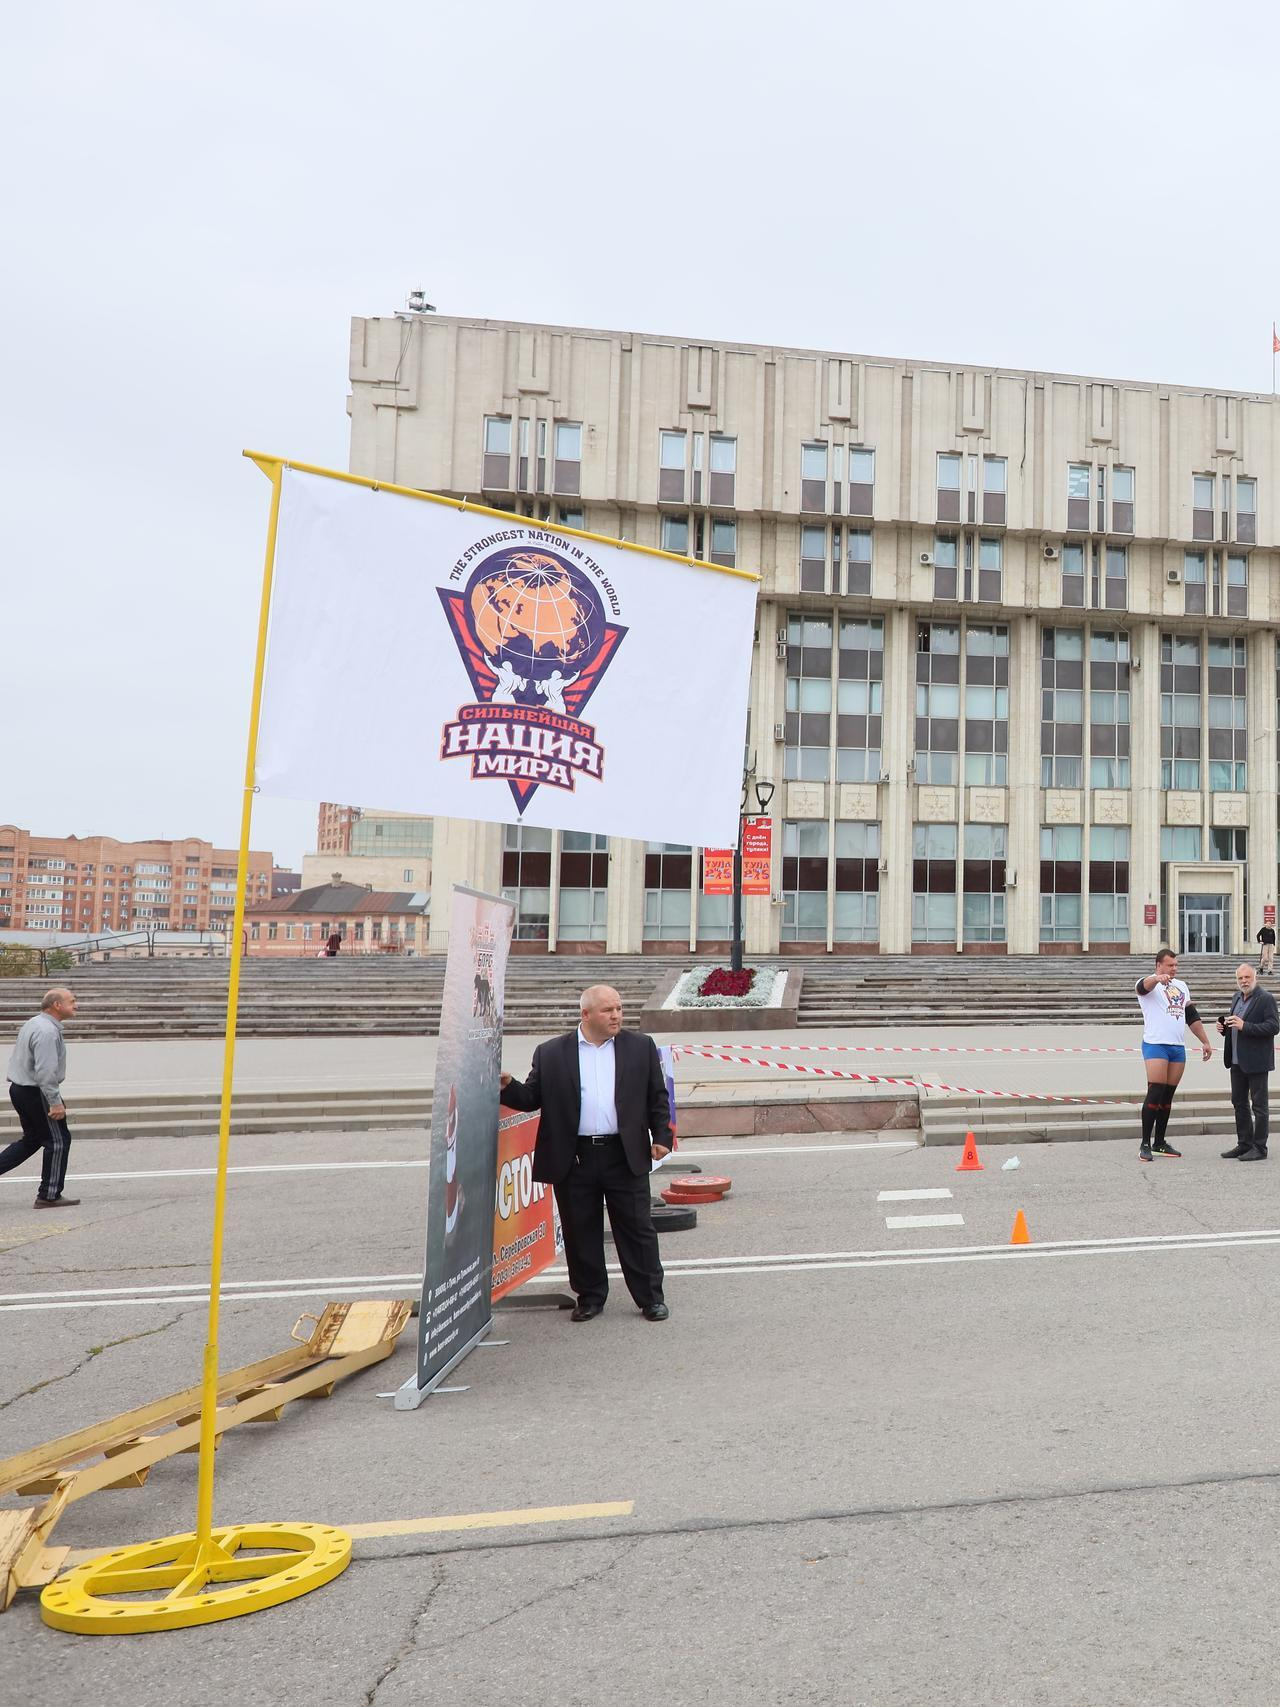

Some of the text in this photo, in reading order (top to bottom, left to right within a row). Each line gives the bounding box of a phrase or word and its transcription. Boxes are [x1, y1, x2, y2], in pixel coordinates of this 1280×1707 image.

[449, 561, 468, 582] THE
[467, 529, 525, 562] STRONGEST
[528, 530, 571, 551] NATION
[570, 547, 585, 560] IN
[584, 556, 605, 578] THE
[601, 577, 621, 616] WORLD
[462, 706, 592, 739] СИЛЬНЕЙШАЯ
[446, 723, 600, 775] НАЦИЯ
[477, 754, 570, 786] МИРА
